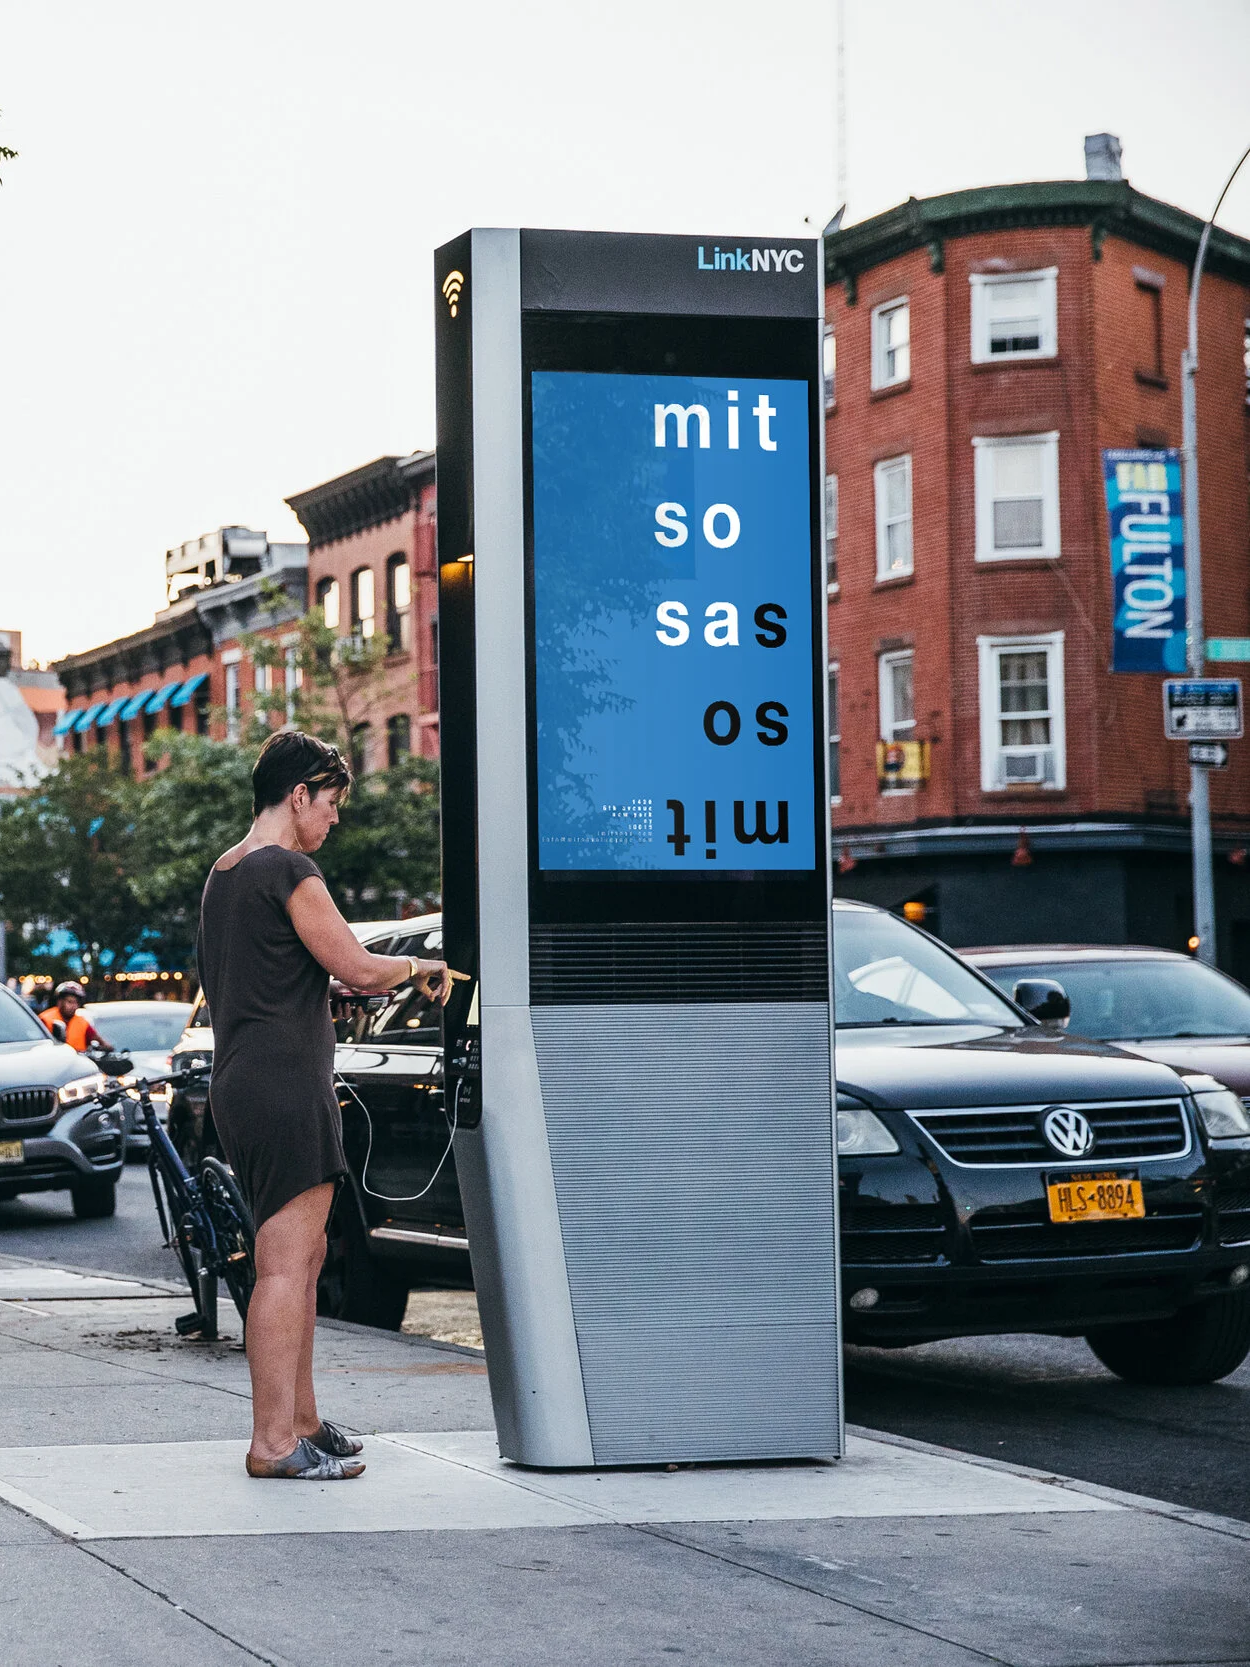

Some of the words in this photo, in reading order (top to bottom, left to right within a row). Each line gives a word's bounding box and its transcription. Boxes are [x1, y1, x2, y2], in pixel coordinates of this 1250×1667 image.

[698, 246, 804, 273] LinkNYC
[654, 390, 777, 451] mit
[654, 502, 740, 549] so
[1118, 492, 1174, 638] FULTON
[655, 601, 788, 648] sas
